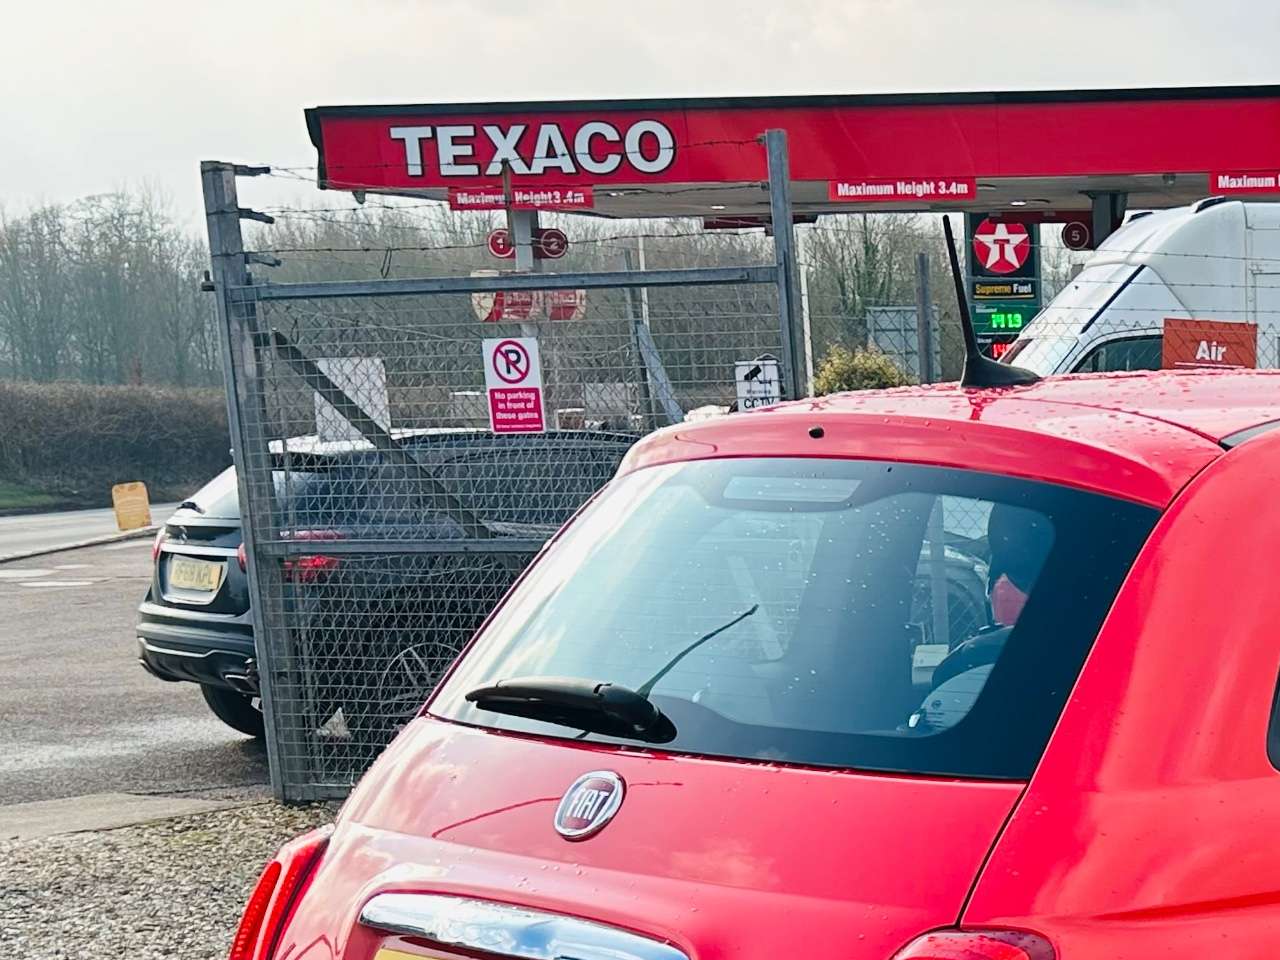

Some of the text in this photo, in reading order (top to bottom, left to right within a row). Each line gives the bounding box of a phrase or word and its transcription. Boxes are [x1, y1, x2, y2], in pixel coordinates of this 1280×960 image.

[390, 120, 674, 176] TEXACO
[837, 181, 968, 197] Maximum Height 3.4m
[1218, 174, 1275, 189] Maximum
[515, 191, 552, 206] Height
[1072, 230, 1081, 241] 5
[975, 283, 1032, 295] Supreme Fuel
[1195, 340, 1227, 361] Air
[494, 391, 536, 401] No parking
[498, 401, 535, 409] in front of
[566, 787, 610, 820] FIAT
